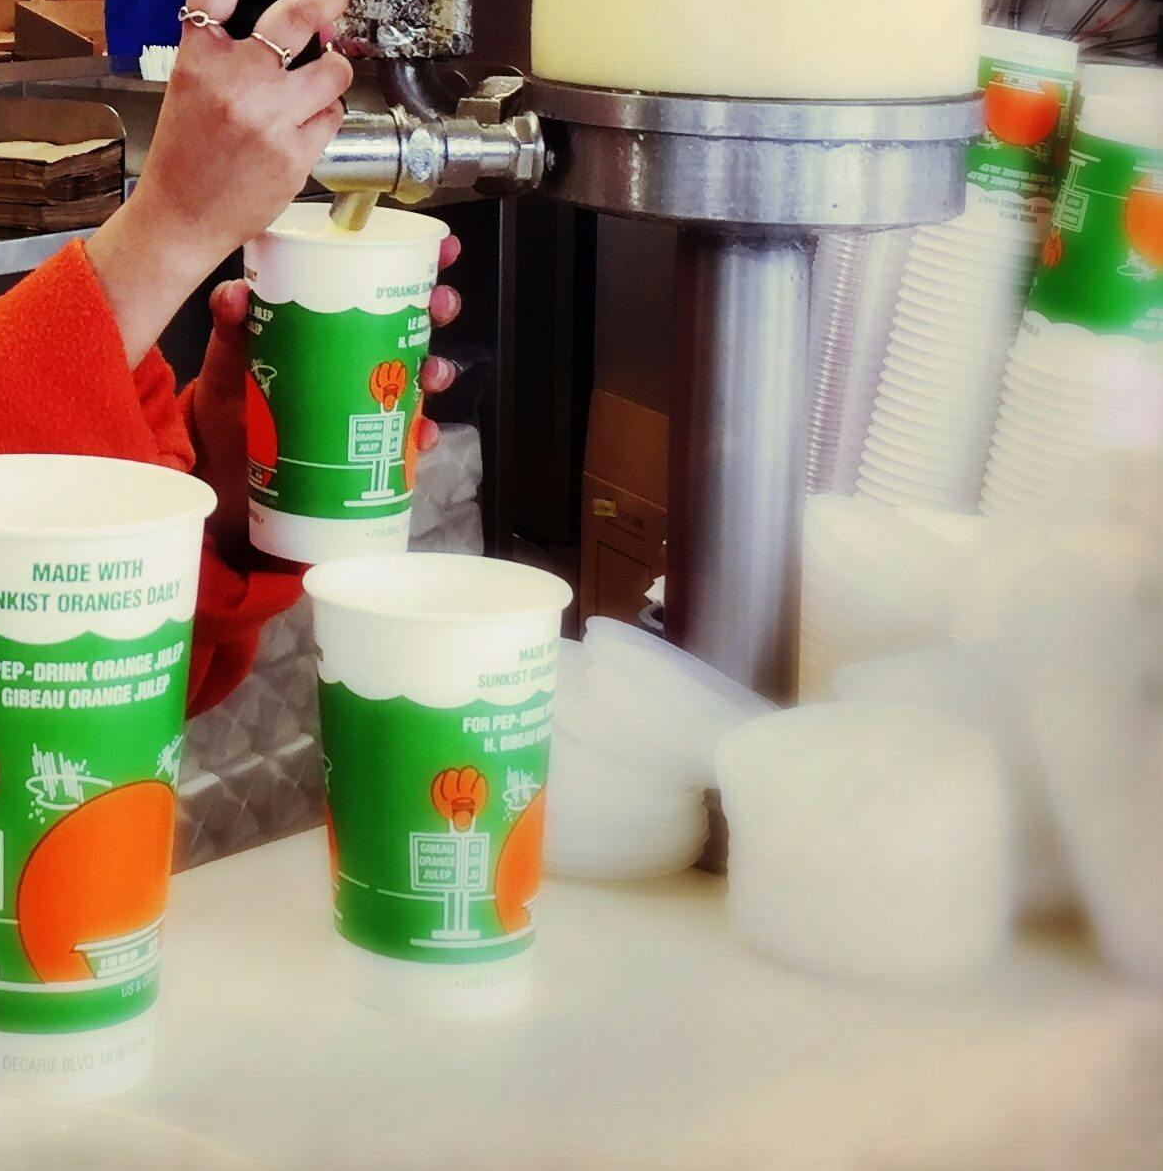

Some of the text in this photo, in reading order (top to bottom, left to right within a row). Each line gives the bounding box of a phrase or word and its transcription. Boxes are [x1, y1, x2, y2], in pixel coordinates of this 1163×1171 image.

[376, 283, 420, 300] D'ORANGE
[31, 559, 144, 583] MADE WITH
[57, 589, 143, 614] ORANGES
[146, 579, 182, 606] DAILY
[92, 654, 154, 680] ORANGE
[154, 640, 185, 671] JULEP
[518, 644, 545, 662] MADE
[477, 668, 528, 690] SUNKIST
[1, 687, 66, 710] GIBEAU
[68, 683, 133, 710] ORANGE
[134, 673, 171, 702] JULEP
[462, 715, 491, 734] FOR
[483, 729, 538, 753] H. GIBEAU
[418, 843, 456, 855] GIBEAU
[417, 855, 457, 868] ORANGE
[421, 868, 453, 881] JULEP
[1, 1051, 60, 1074] DECARIE
